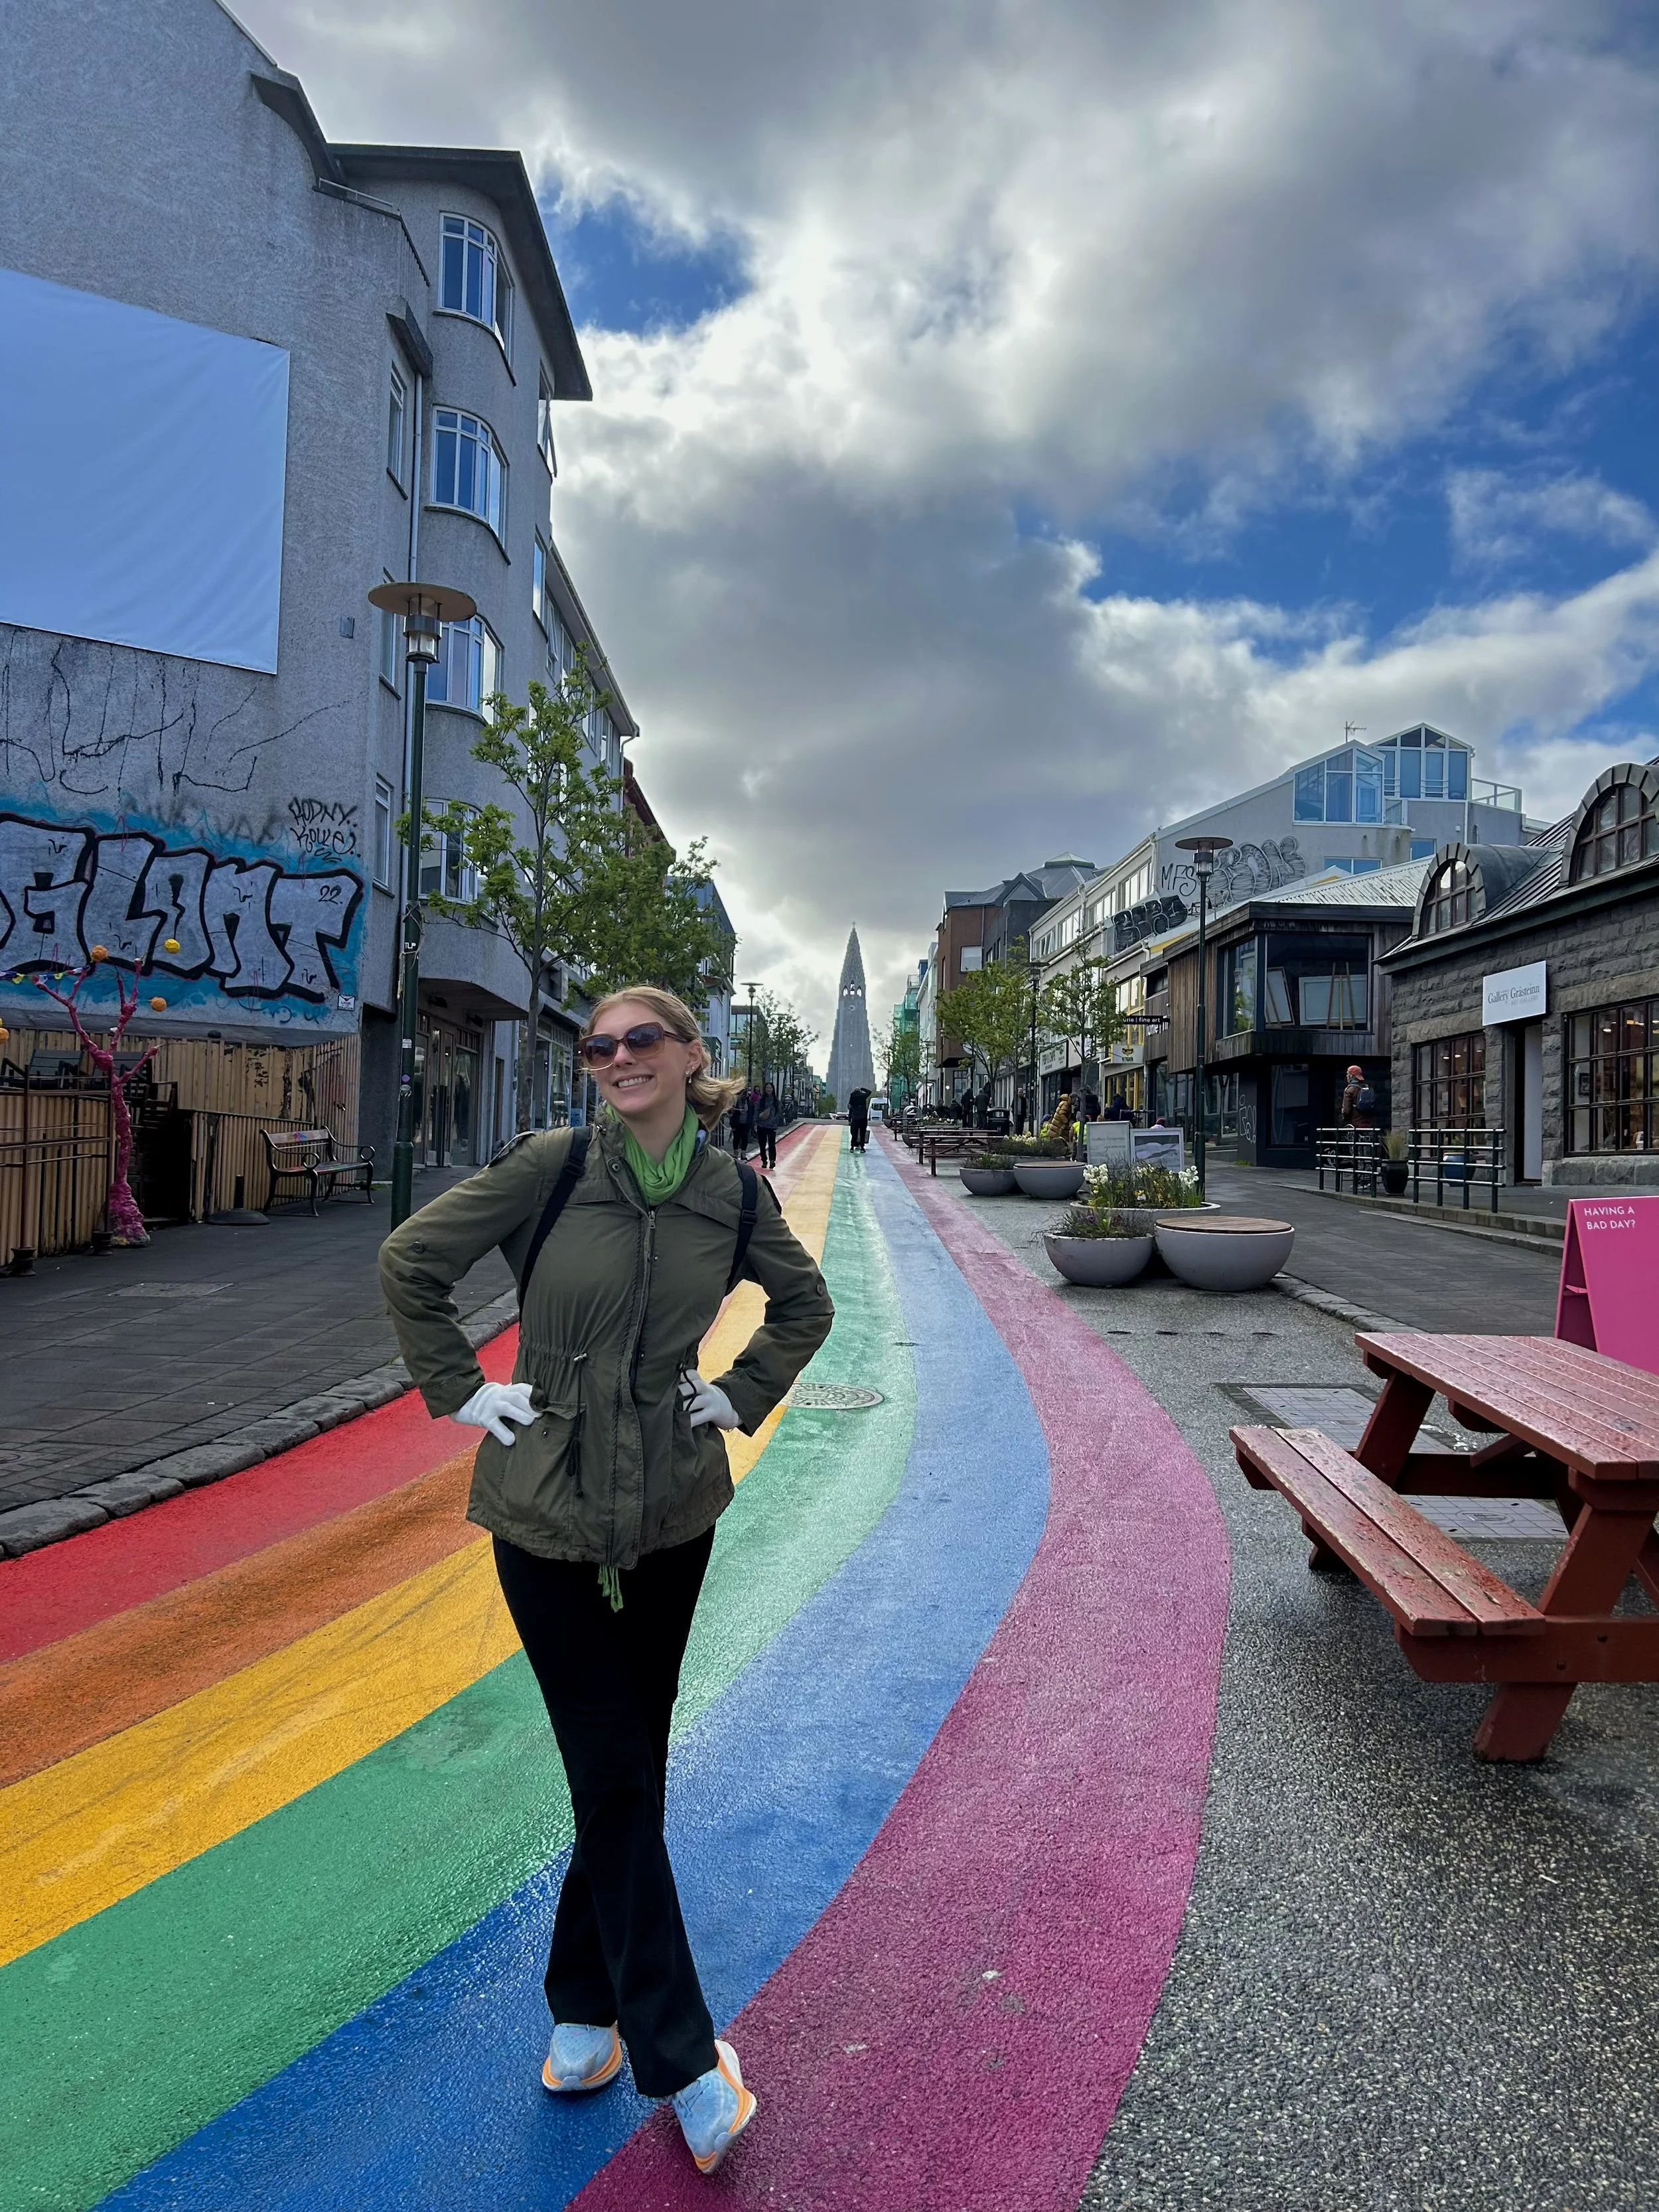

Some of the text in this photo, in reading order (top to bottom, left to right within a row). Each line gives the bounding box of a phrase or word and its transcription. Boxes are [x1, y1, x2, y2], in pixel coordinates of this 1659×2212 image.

[1488, 990, 1508, 1003] Gallery
[1584, 1206, 1624, 1216] HAVING
[1586, 1219, 1636, 1230] BAD DAY?
